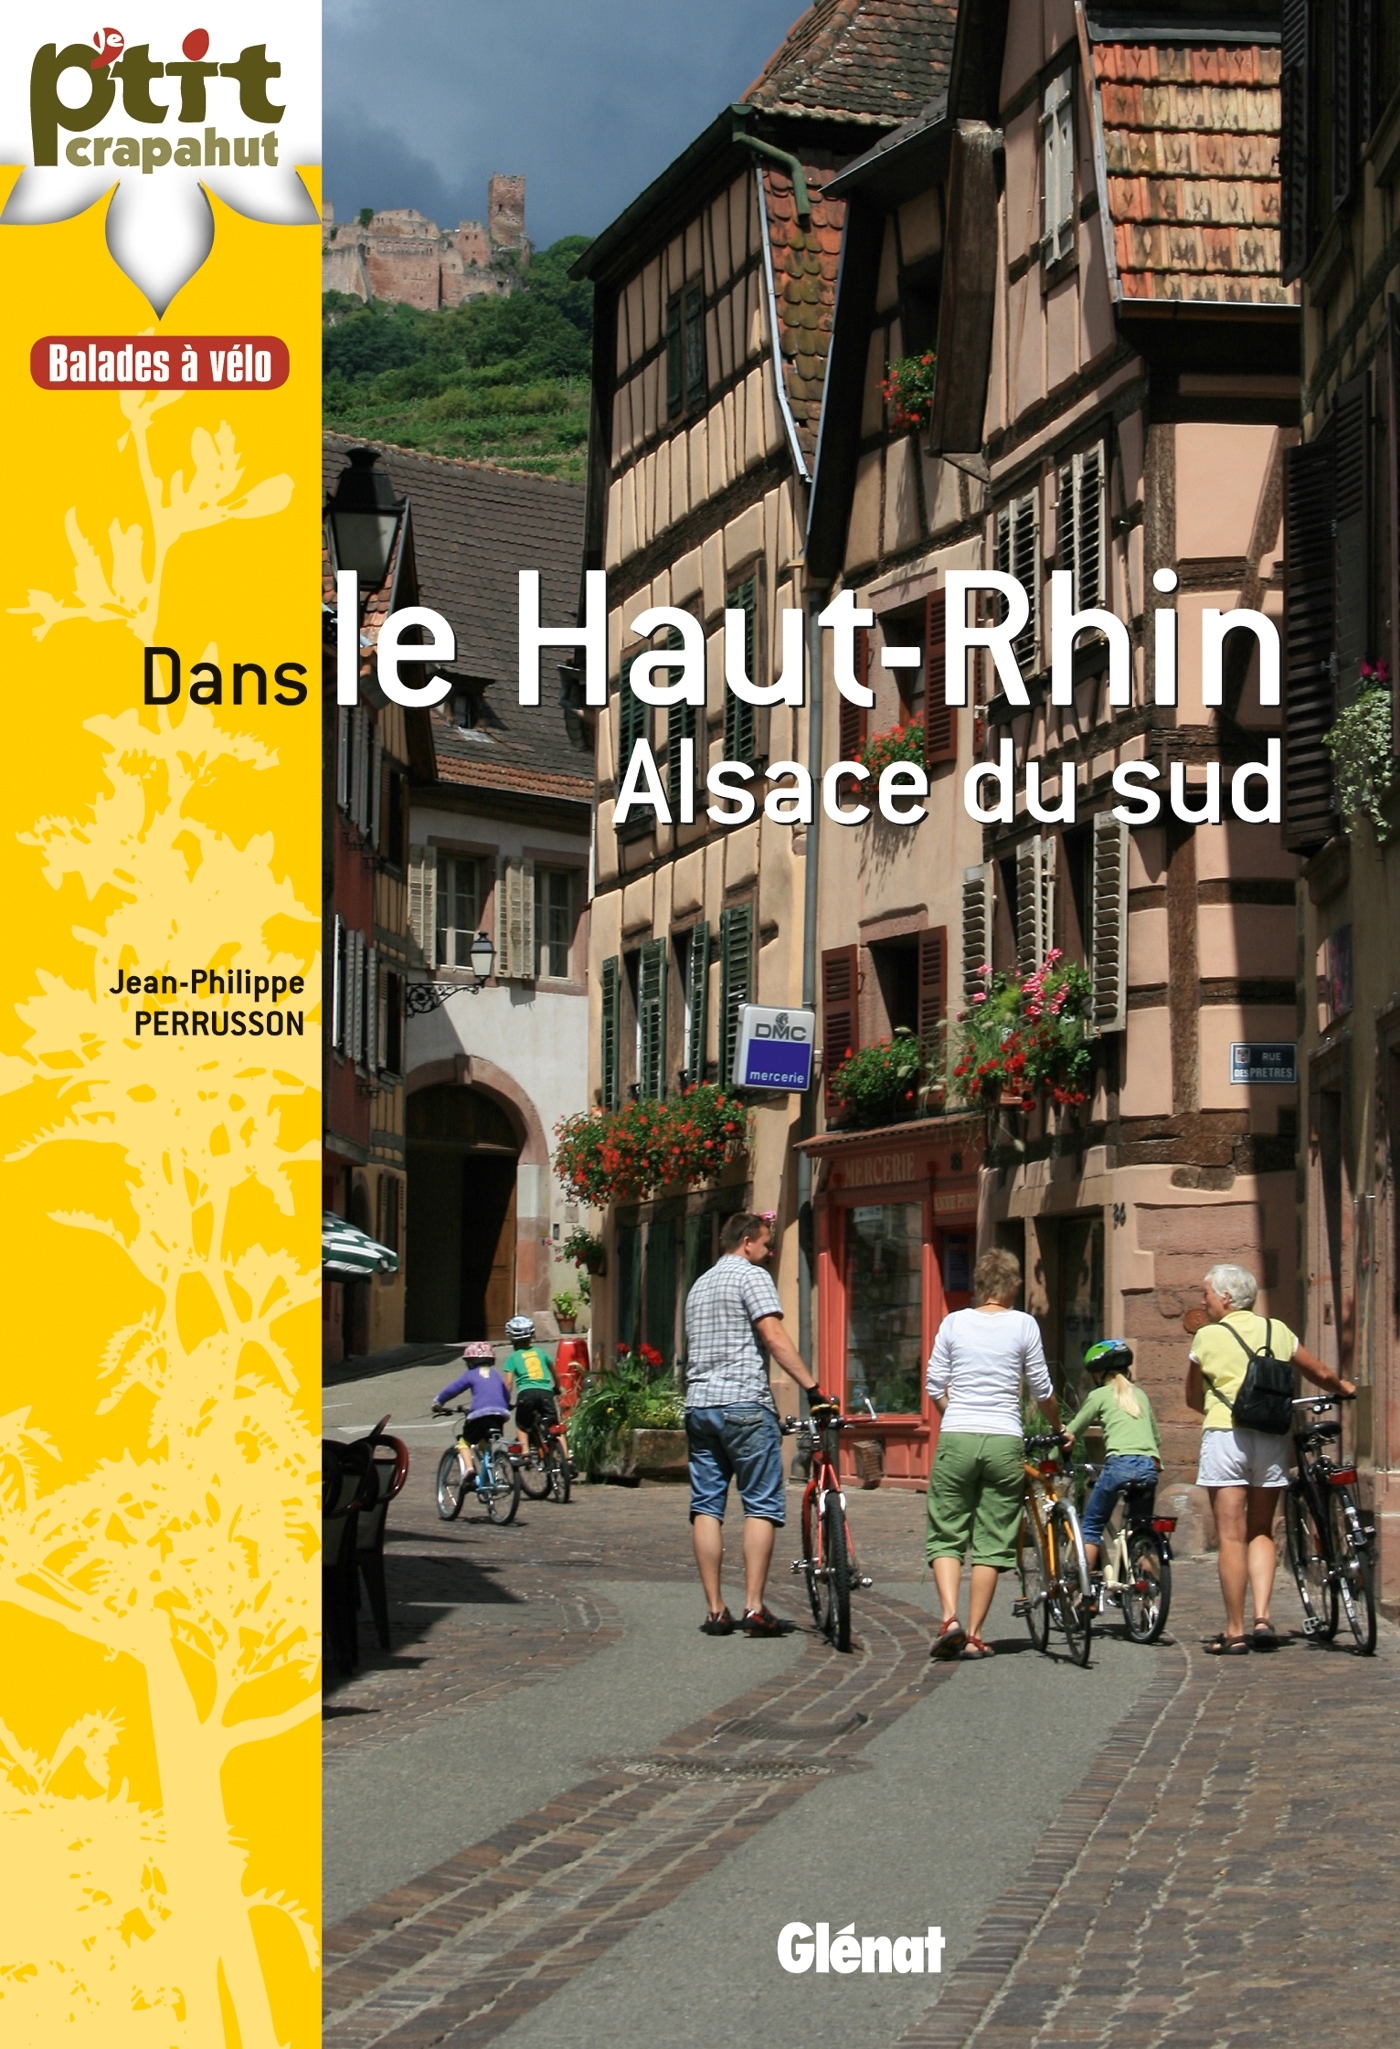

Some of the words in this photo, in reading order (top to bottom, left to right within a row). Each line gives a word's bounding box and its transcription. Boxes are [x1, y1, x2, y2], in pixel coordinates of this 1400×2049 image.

[754, 1023, 807, 1041] DMC
[1262, 1052, 1282, 1061] RUE
[749, 1070, 805, 1084] mercerie
[1234, 1068, 1248, 1078] DES
[1250, 1067, 1293, 1078] PRETRES
[844, 1151, 916, 1188] MERCERIE
